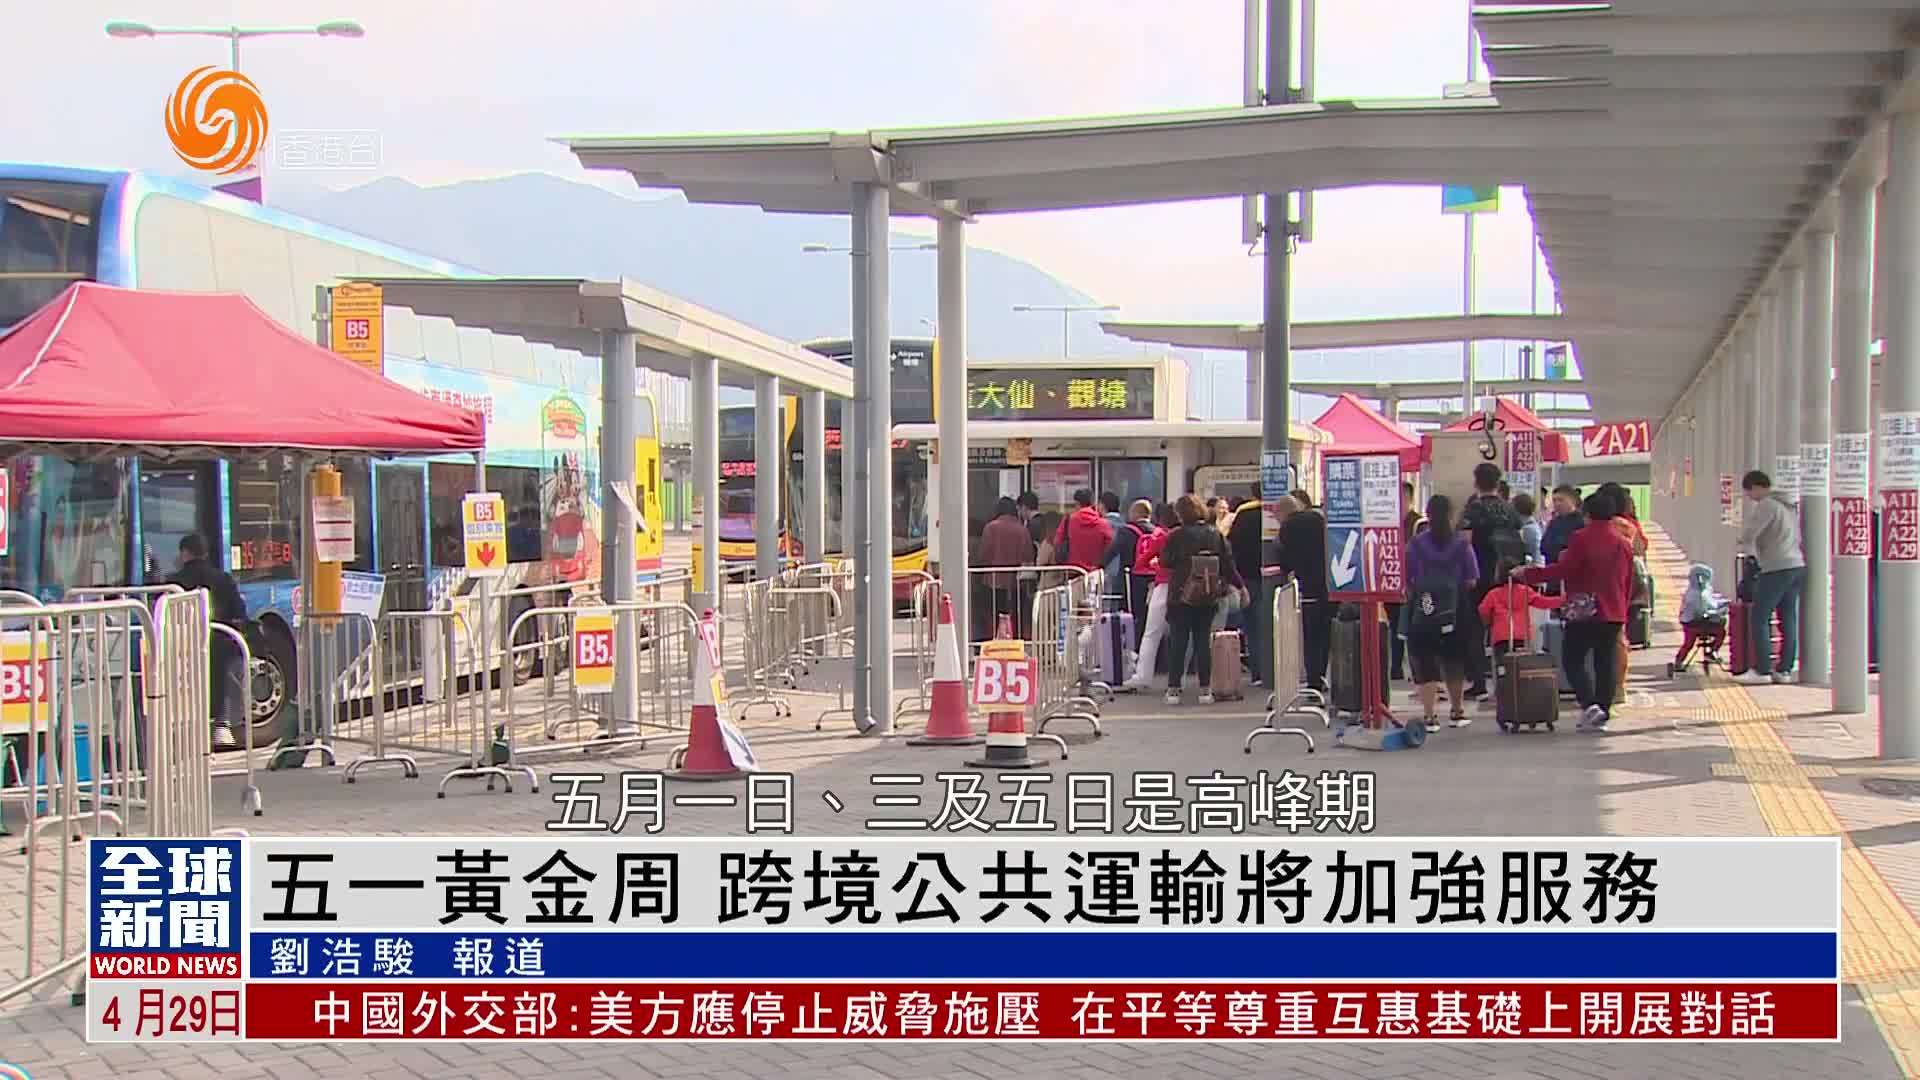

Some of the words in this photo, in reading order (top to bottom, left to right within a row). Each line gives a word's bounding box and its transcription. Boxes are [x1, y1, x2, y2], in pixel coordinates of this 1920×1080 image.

[346, 320, 369, 339] B5
[1608, 421, 1649, 454] A21
[1845, 501, 1866, 513] A11
[1888, 494, 1915, 508] A11
[475, 503, 493, 520] B5
[1888, 509, 1916, 524] A21
[1845, 514, 1866, 526] A21
[1379, 529, 1398, 544] A11
[1845, 528, 1867, 540] A22
[1888, 527, 1917, 541] A22
[1380, 545, 1399, 559] A21
[1845, 542, 1867, 554] A29
[1888, 543, 1916, 558] A29
[1380, 560, 1400, 575] A22
[1381, 576, 1400, 591] A29
[578, 633, 609, 666] B5
[1, 664, 44, 698] B5
[977, 660, 1029, 703] B5
